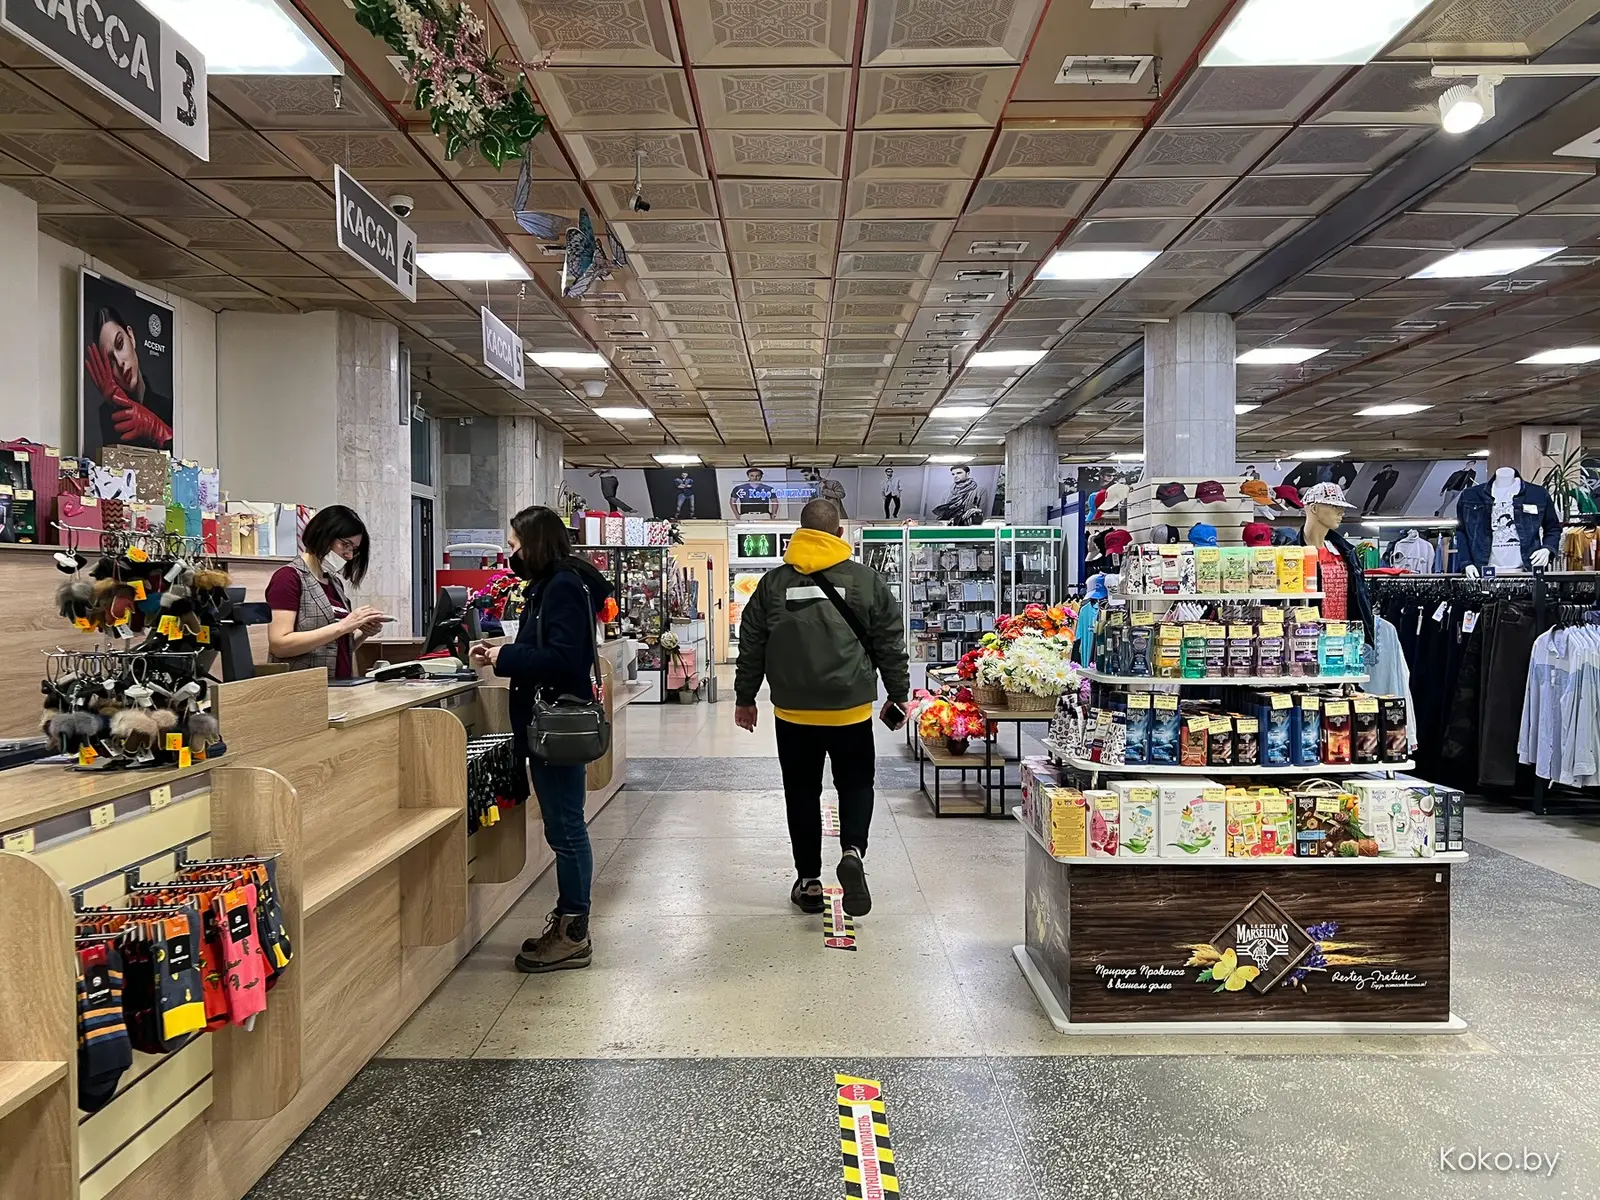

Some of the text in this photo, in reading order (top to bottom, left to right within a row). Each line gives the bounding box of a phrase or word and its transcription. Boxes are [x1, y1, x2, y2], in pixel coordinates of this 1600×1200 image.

[175, 50, 197, 127] 3
[342, 194, 413, 287] КАССА 4
[144, 340, 165, 352] ACCENT
[486, 325, 522, 378] КАССА 5
[1095, 964, 1186, 979] Природа Прованса
[1106, 978, 1173, 993] в вашем доме
[852, 1084, 866, 1101] STOP
[858, 1114, 876, 1158] ПОКУПАТЕЛЬ
